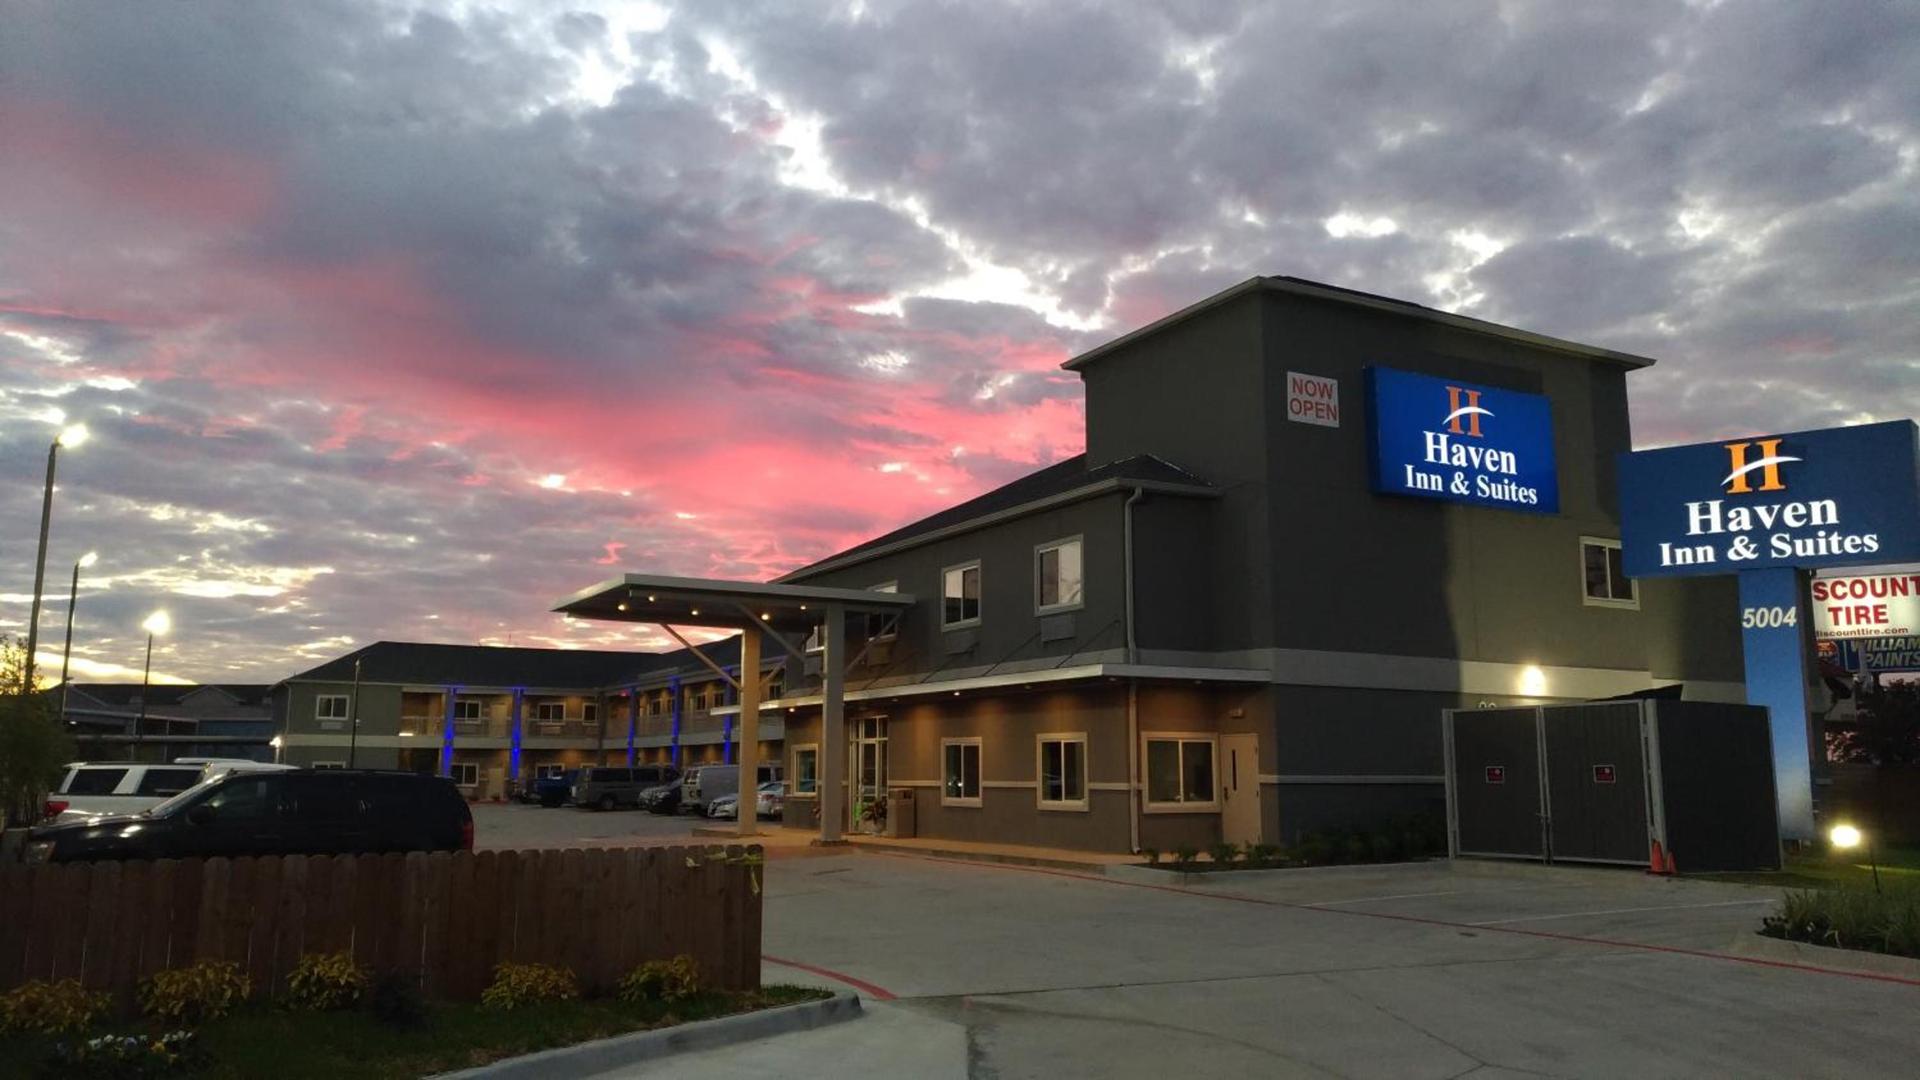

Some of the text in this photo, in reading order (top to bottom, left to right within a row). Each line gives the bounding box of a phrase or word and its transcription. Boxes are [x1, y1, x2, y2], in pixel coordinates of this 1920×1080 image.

[1292, 377, 1333, 399] NOW
[1290, 398, 1337, 421] OPEN
[1423, 430, 1517, 475] Haven
[1404, 464, 1537, 504] Inn & Suites
[1684, 499, 1840, 536] Haven
[1658, 530, 1879, 567] Inn & Suites
[1742, 606, 1797, 629] 5004
[1827, 604, 1889, 626] TIRE
